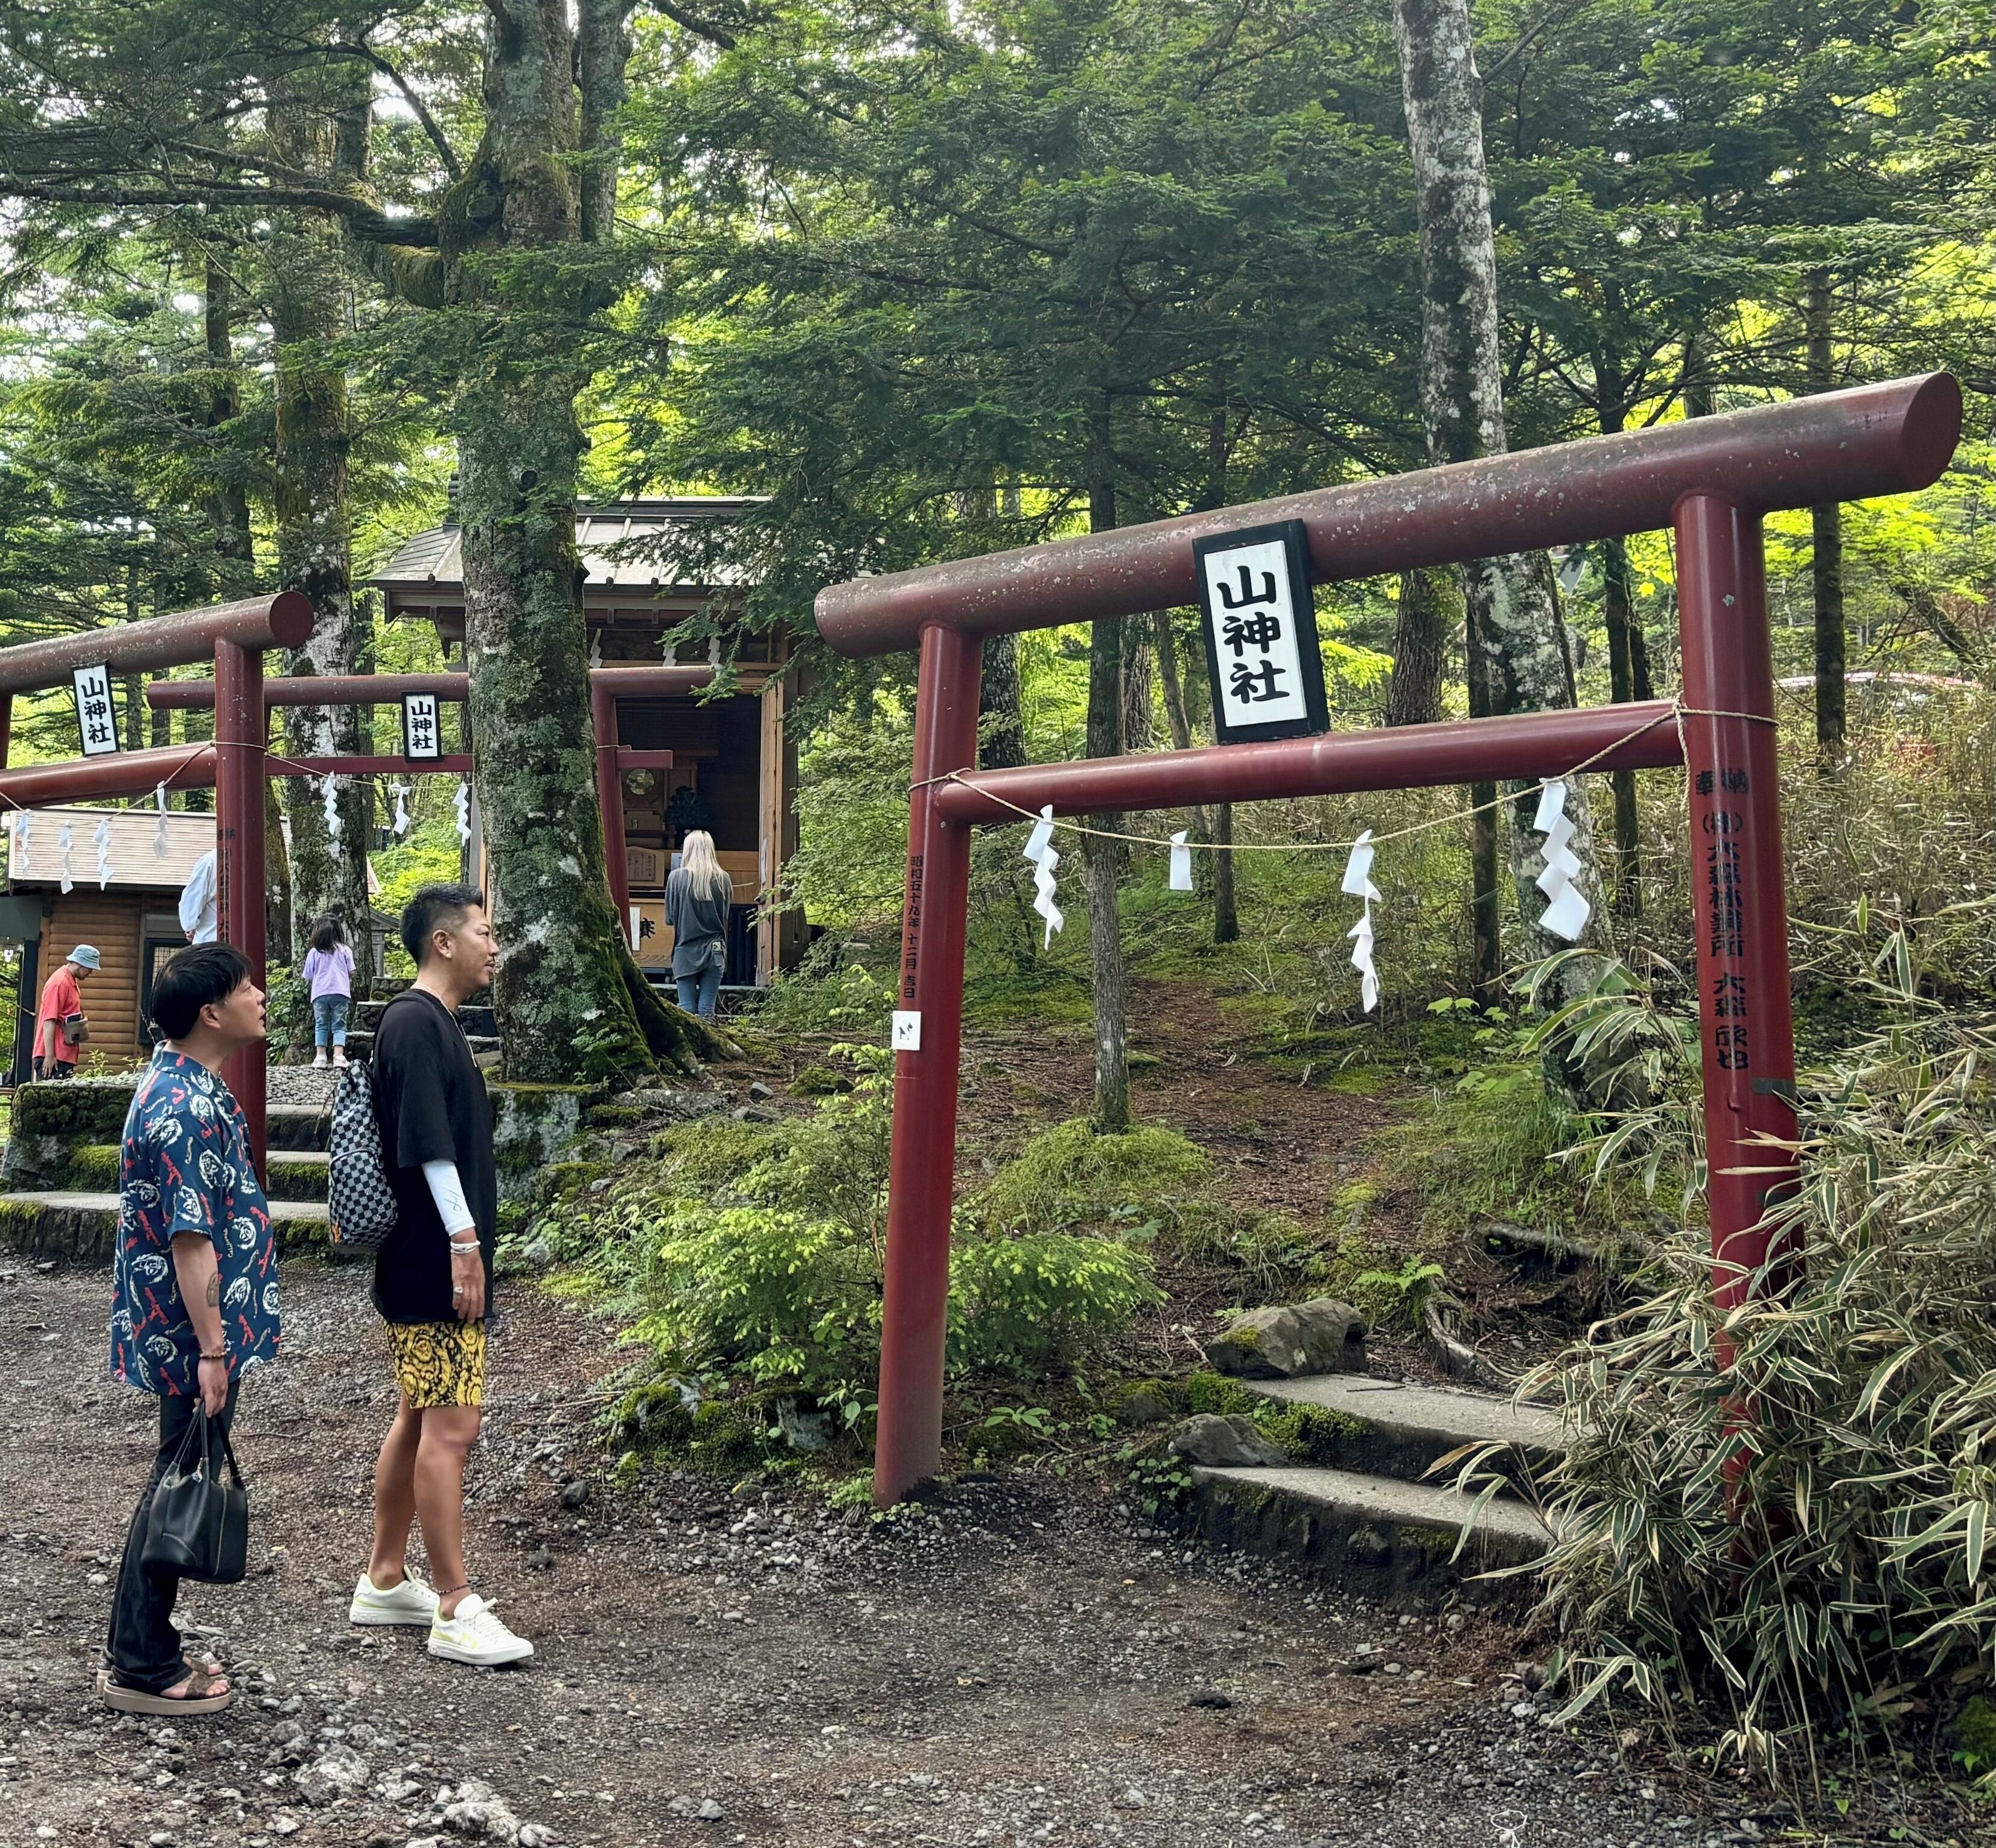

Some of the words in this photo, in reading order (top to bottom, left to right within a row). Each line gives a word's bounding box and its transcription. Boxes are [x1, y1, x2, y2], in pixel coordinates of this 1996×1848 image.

[1216, 565, 1290, 704] 山神社
[81, 677, 112, 744] 山神社
[410, 701, 434, 750] 山神社
